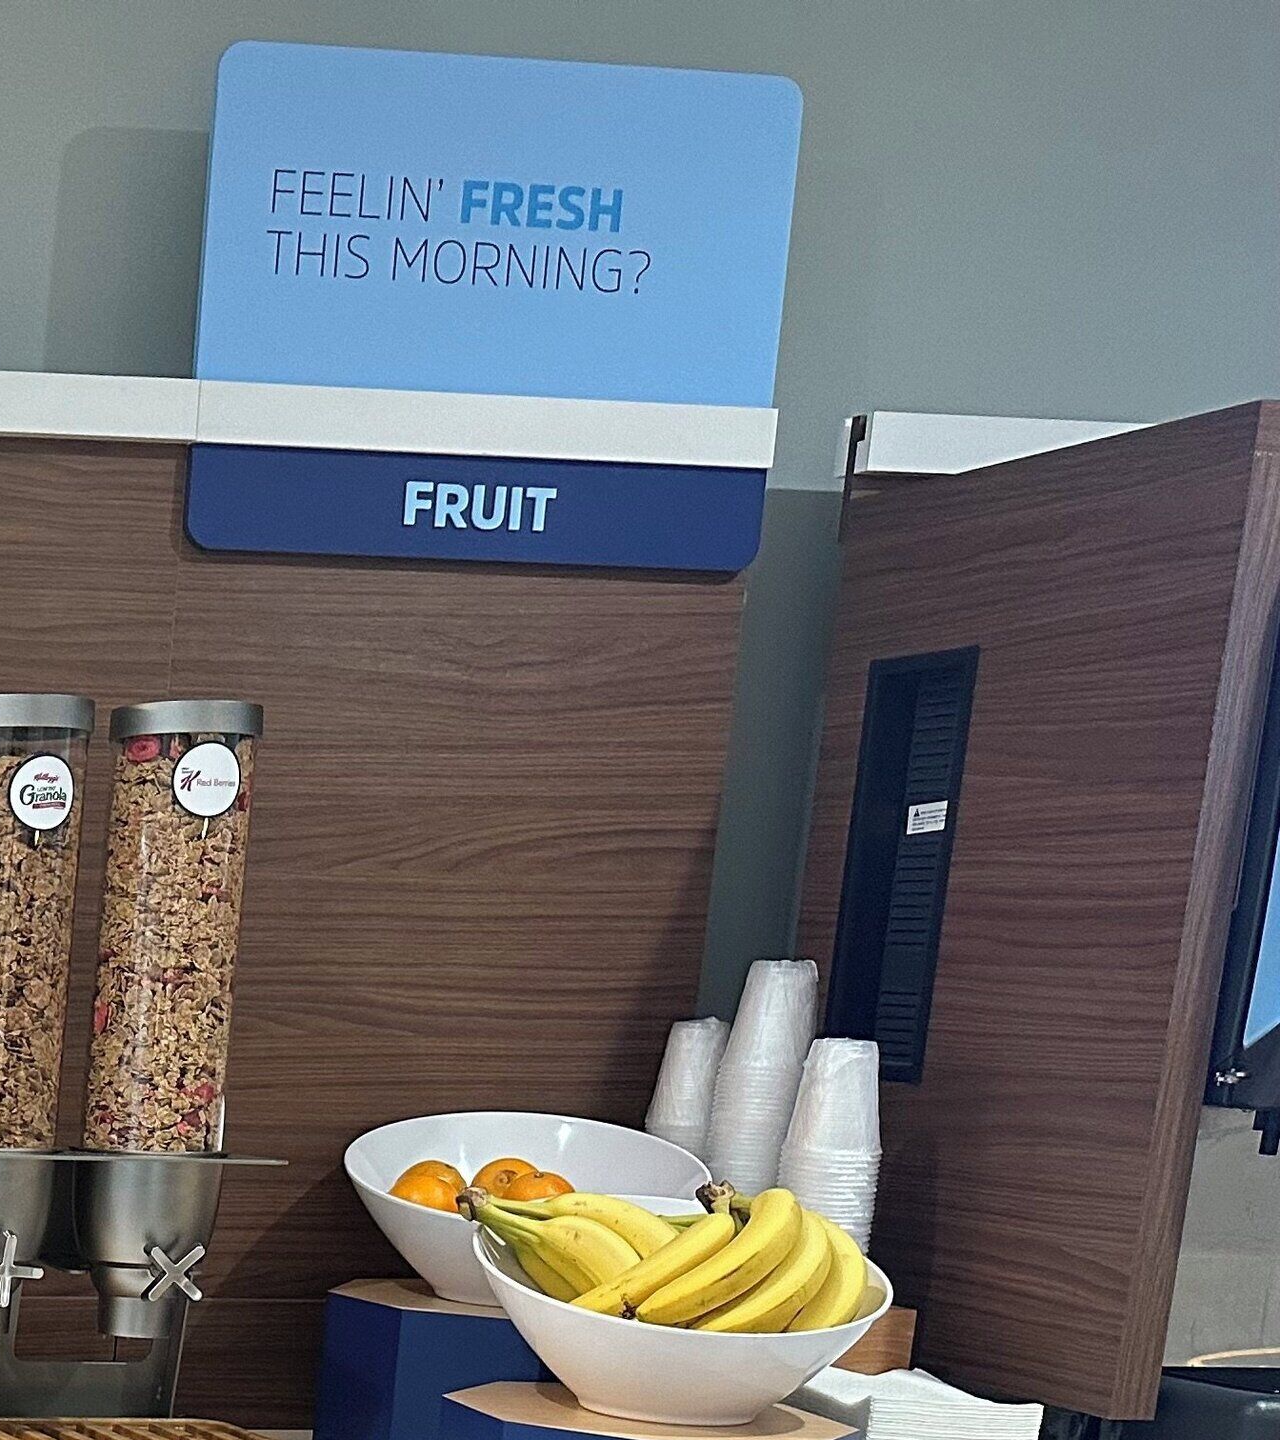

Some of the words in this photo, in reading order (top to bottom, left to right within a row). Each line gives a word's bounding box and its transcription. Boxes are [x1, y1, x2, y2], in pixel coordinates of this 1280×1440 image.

[270, 168, 445, 223] FEELIN'
[460, 179, 624, 234] FRESH
[266, 229, 371, 281] THIS
[391, 237, 653, 295] MORNING?
[402, 480, 558, 532] FRUIT
[19, 784, 67, 806] Granola
[196, 779, 212, 787] Red
[213, 779, 236, 787] Berries
